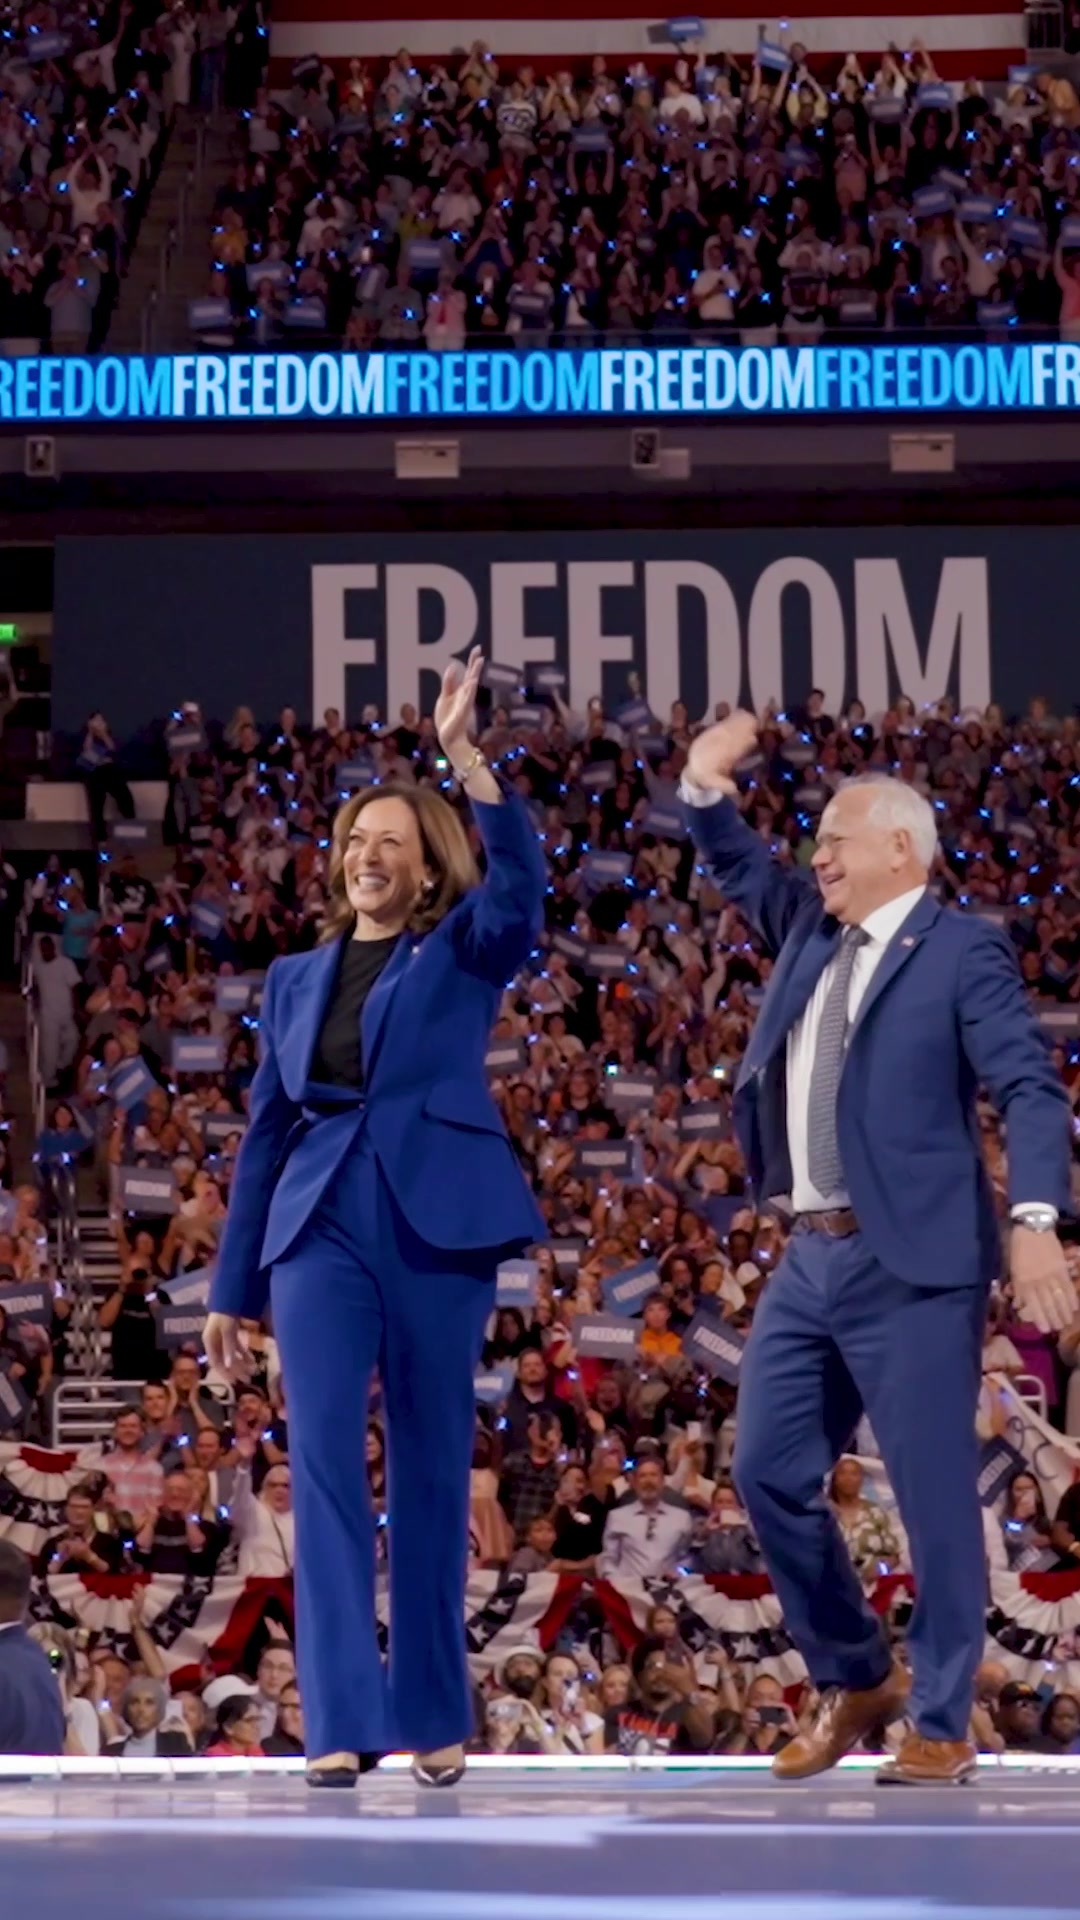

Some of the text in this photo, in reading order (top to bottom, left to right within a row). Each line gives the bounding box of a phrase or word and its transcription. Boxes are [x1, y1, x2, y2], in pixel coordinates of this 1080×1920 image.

[172, 354, 385, 416] FREEDOM
[386, 353, 599, 414] FREEDOM
[600, 348, 815, 412] FREEDOM
[816, 346, 1029, 409] FREEDOM
[1031, 344, 1080, 406] FR
[311, 556, 992, 728] FREEDOM
[580, 1326, 635, 1343] FREEDOM
